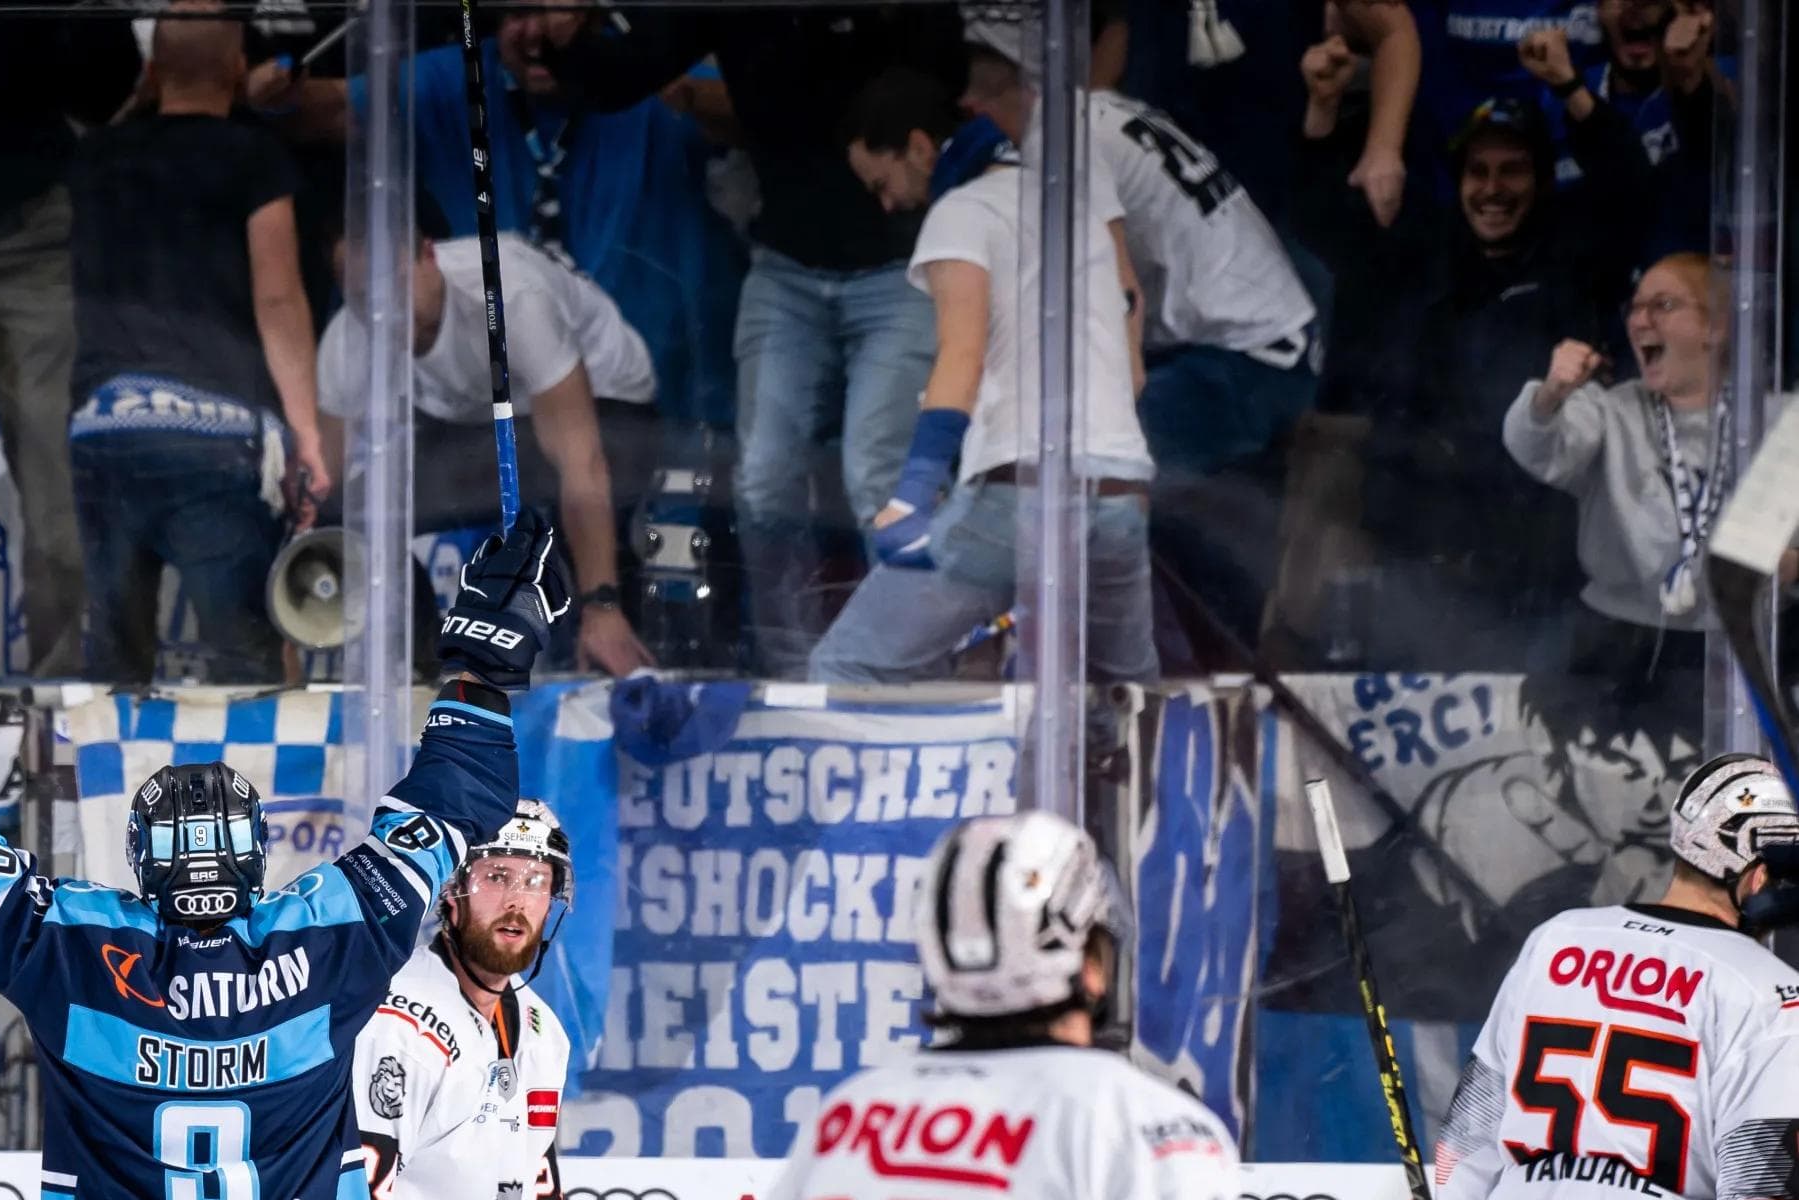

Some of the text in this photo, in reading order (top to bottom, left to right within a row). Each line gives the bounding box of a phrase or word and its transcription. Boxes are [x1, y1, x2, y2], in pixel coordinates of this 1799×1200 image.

[487, 303, 497, 330] STORM
[1348, 684, 1494, 770] ERC!
[617, 741, 1017, 829] EUTSCHER
[194, 826, 207, 846] 9
[264, 821, 345, 860] POR
[190, 871, 218, 880] ERC
[1623, 920, 1675, 936] CCM
[167, 946, 310, 1021] SATURN
[1549, 946, 1703, 1024] ORION
[136, 1034, 268, 1090] STORM
[383, 990, 462, 1062] techem
[1503, 1015, 1700, 1194] 55
[813, 1101, 1034, 1189] ORION
